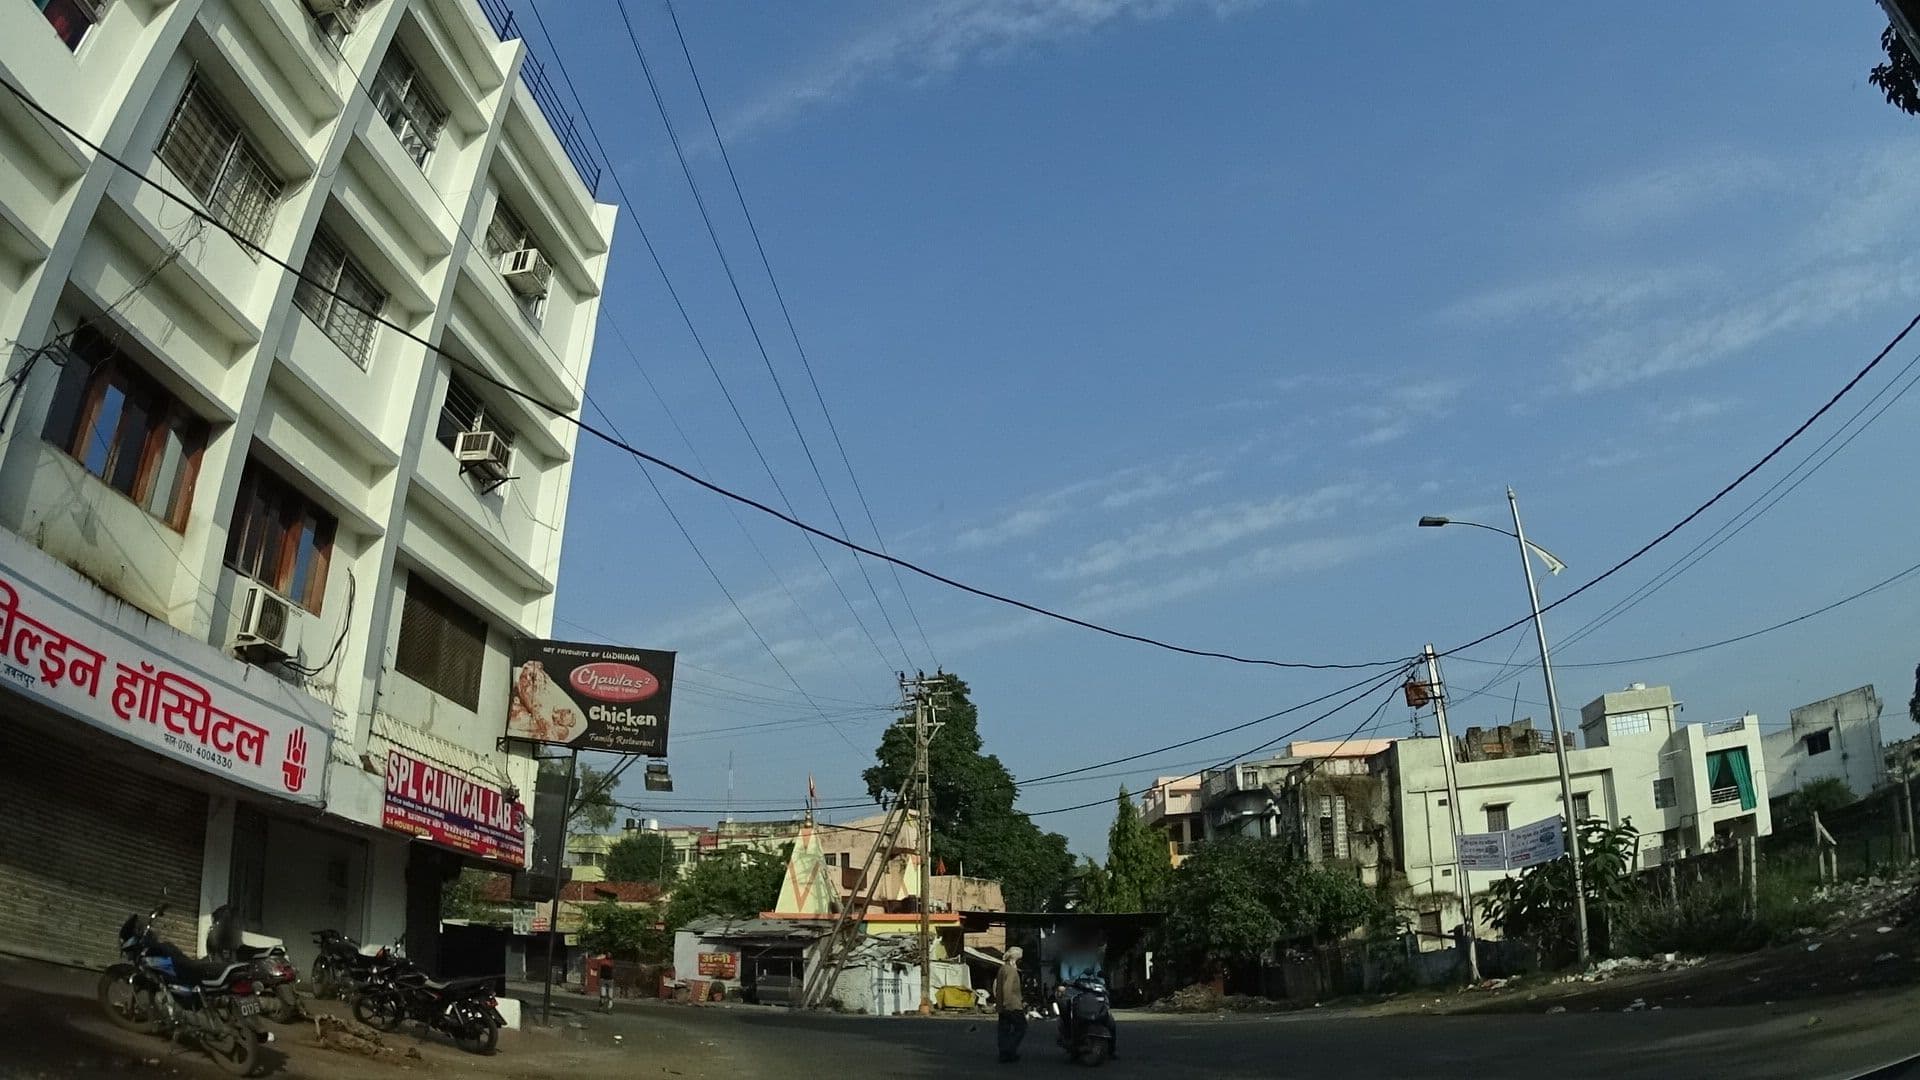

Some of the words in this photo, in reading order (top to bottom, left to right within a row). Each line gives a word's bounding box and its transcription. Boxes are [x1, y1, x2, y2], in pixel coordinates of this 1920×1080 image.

[602, 651, 640, 661] LUDHIANA
[111, 661, 269, 766] हॉस्पिटल
[589, 704, 657, 727] Chicken
[388, 752, 417, 799] SPL
[421, 767, 486, 823] CLINICAL
[489, 792, 512, 831] LAB
